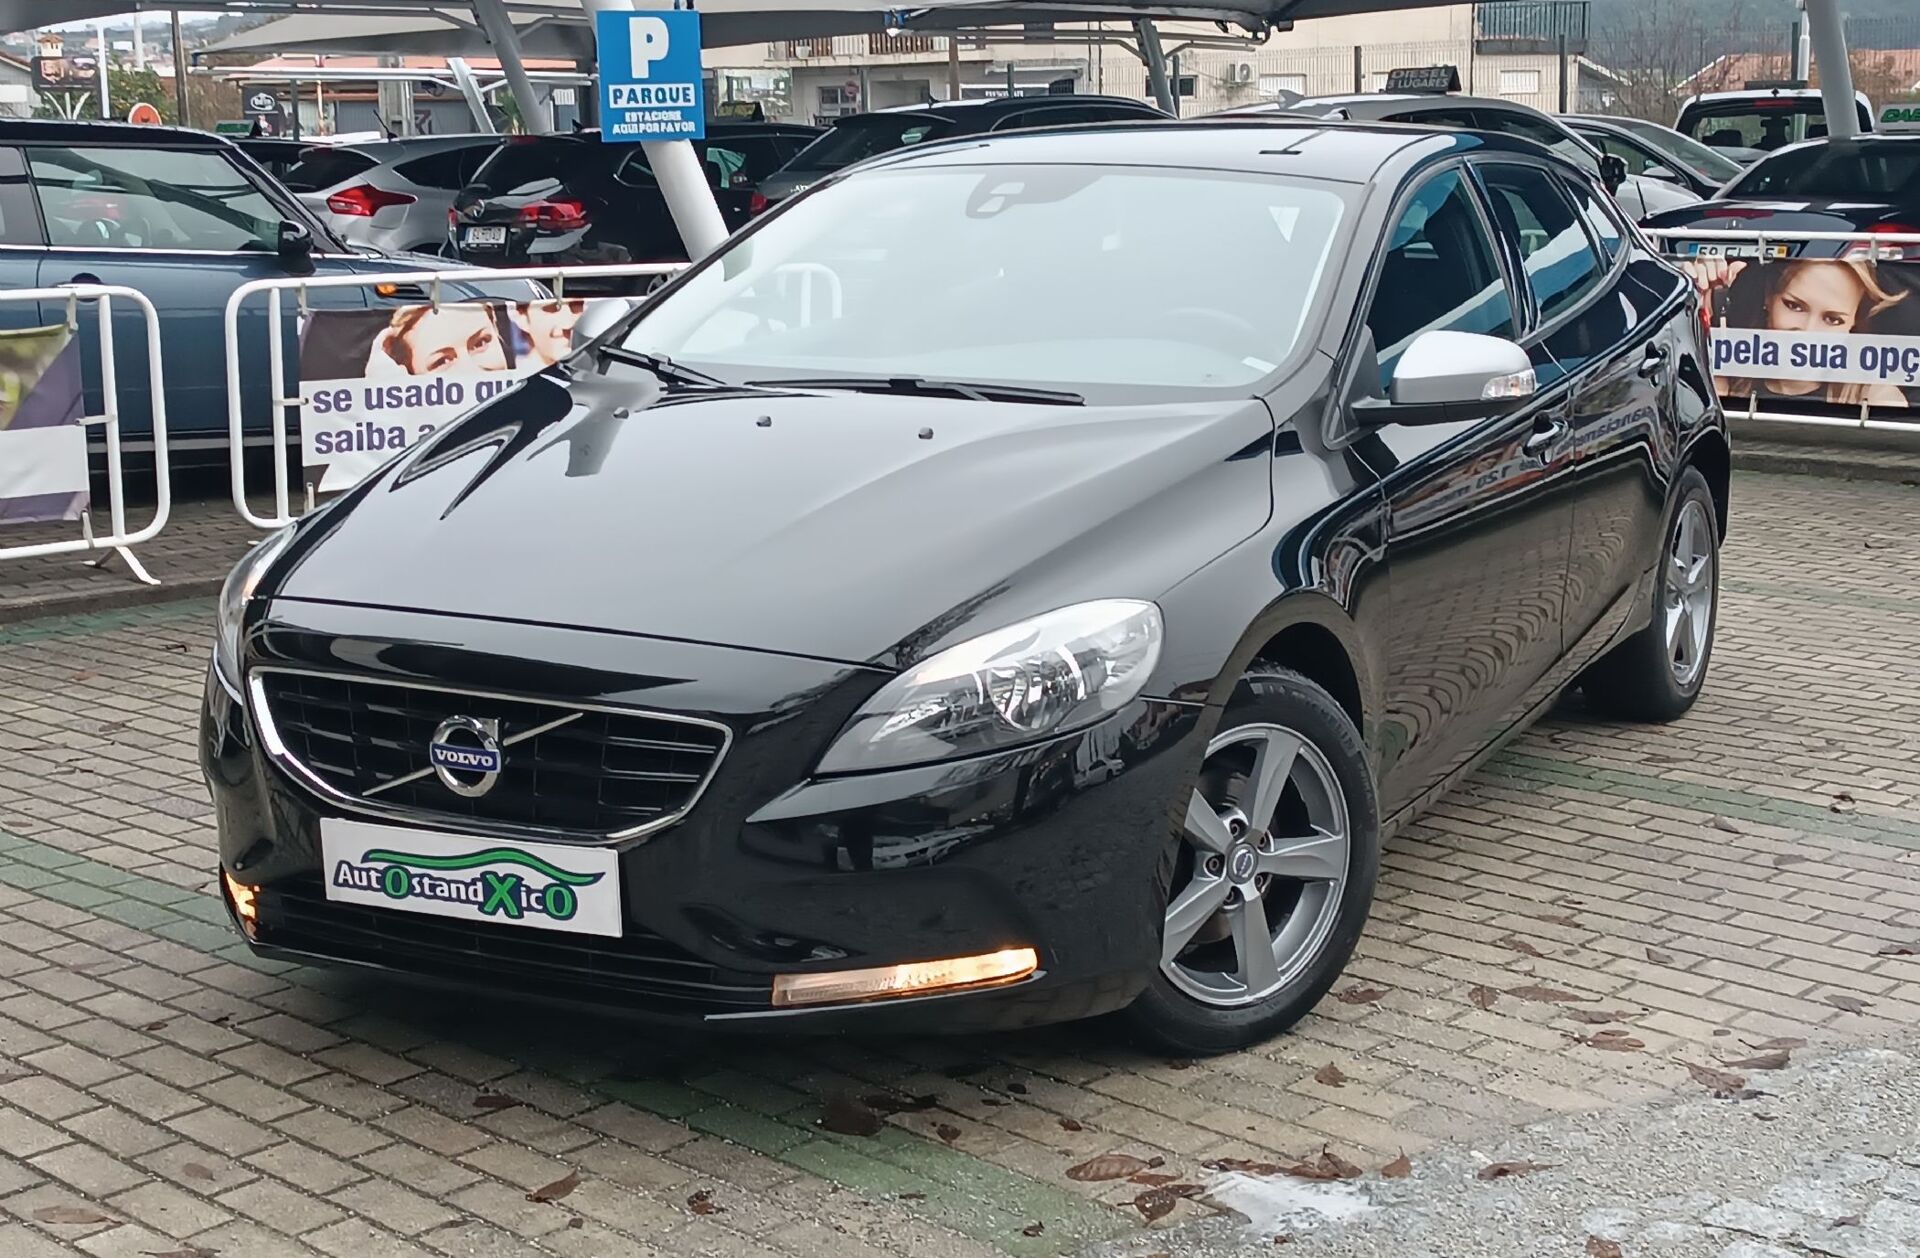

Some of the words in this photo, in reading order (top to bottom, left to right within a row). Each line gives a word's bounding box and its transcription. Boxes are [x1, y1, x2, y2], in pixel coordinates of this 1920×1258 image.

[628, 16, 669, 78] P
[1391, 68, 1448, 79] DIESEL
[1398, 78, 1448, 88] LUGARES
[612, 86, 691, 105] PARQUE
[625, 110, 682, 122] ESTACIONE
[639, 122, 660, 133] POR
[661, 121, 696, 133] FAVOR
[1713, 334, 1779, 370] pela
[1790, 342, 1847, 369] sua
[1859, 345, 1920, 383] opç
[312, 388, 352, 414] se
[364, 377, 464, 411] usado
[314, 421, 407, 455] saiba
[434, 748, 494, 767] VOLVO
[334, 861, 578, 920] AutOstandXicO
